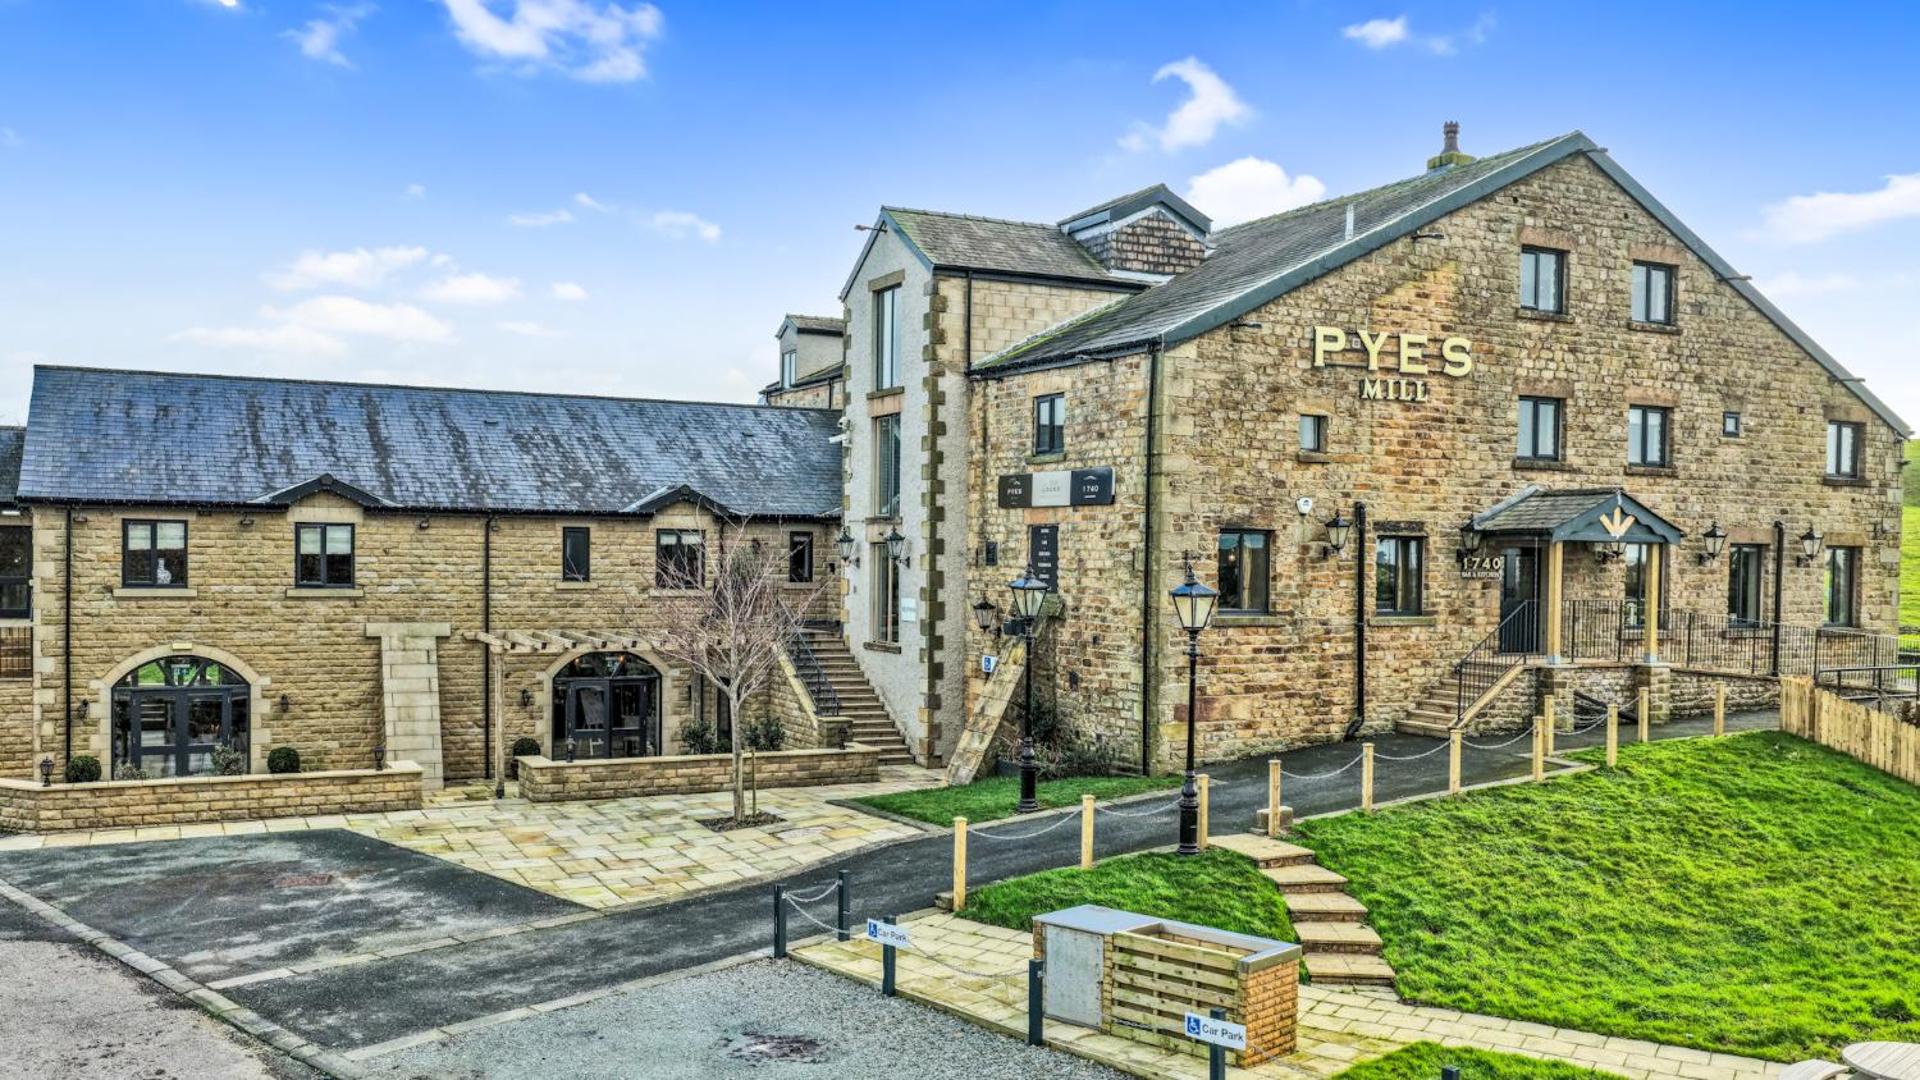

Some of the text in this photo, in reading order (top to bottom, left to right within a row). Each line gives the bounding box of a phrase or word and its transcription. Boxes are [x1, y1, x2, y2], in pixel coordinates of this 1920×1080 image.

[1313, 325, 1473, 378] PYES
[1361, 378, 1429, 401] MILL
[1463, 557, 1501, 570] 1740
[1202, 1023, 1244, 1042] Car Park
